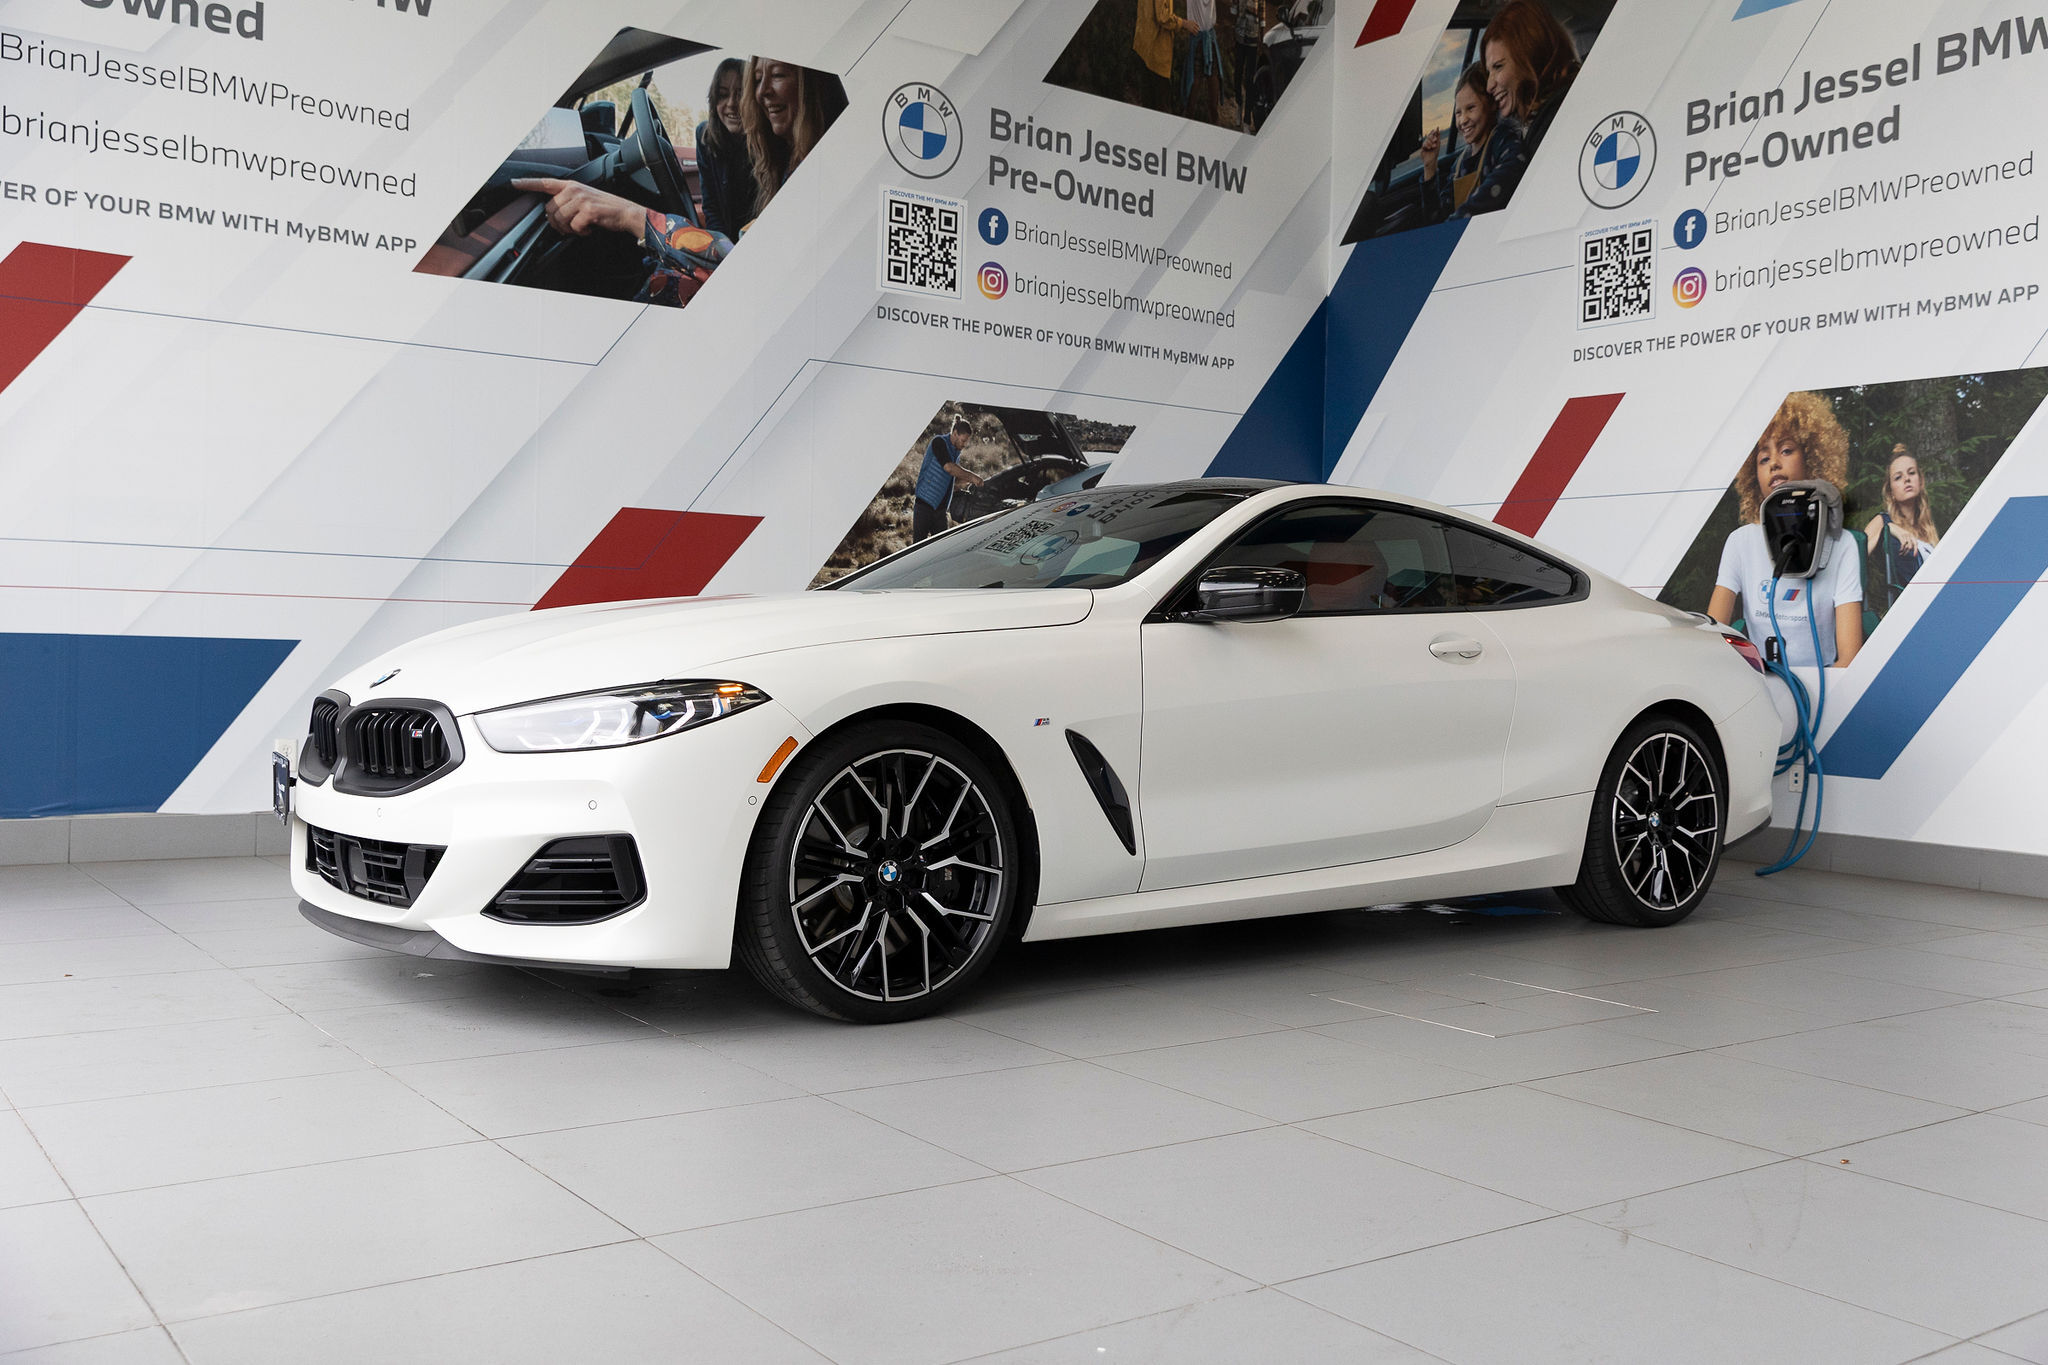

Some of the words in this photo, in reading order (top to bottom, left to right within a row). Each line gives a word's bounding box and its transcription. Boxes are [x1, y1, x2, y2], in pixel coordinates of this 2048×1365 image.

[80, 0, 264, 41] wned
[1, 32, 409, 131] BrianJesselBMWPreowned
[894, 87, 953, 118] BMW
[1686, 90, 1784, 137] Brian
[1794, 42, 1921, 115] Jessel
[1936, 15, 2048, 76] BMW
[2, 105, 416, 197] brianjesselbmwpreowned
[990, 107, 1072, 156] Brian
[1079, 129, 1167, 177] Jessel
[1176, 150, 1248, 195] BMW
[1589, 116, 1647, 148] BMW
[1685, 103, 1901, 187] Pre-Owned
[0, 181, 37, 202] ER
[44, 187, 78, 207] OF
[84, 191, 151, 217] YOUR
[158, 202, 215, 225] BMW
[222, 211, 279, 235] WITH
[286, 221, 370, 247] MyBMW
[375, 234, 417, 254] APP
[889, 189, 915, 199] DISCOVER
[934, 198, 947, 206] BMW
[988, 155, 1154, 218] Pre-Owned
[1715, 150, 2033, 234] BrianJesselBMWPreowned
[1014, 220, 1232, 280] BrianJesselBMWPreowned
[1584, 227, 1609, 237] DISCOVER
[1628, 221, 1640, 229] BMW
[1641, 218, 1652, 226] APP
[1715, 215, 2039, 292] brianjesselbmwpreowned
[1014, 272, 1235, 328] brianjesselbmwpreowned
[1573, 339, 1643, 362] DISCOVER
[1646, 335, 1676, 352] THE
[1680, 327, 1736, 348] POWER
[1740, 323, 1762, 339] OF
[1765, 316, 1811, 336] YOUR
[1816, 309, 1860, 329] BMW
[1864, 301, 1910, 322] WITH
[1916, 290, 1992, 317] MyBMW
[1997, 284, 2040, 304] APP
[877, 305, 949, 329] DISCOVER
[952, 317, 980, 334] THE
[984, 321, 1033, 341] POWER
[1036, 329, 1054, 343] OF
[1056, 332, 1091, 350] YOUR
[1094, 338, 1126, 354] BMW
[1128, 343, 1160, 360] WITH
[1163, 348, 1209, 367] MyBMW
[1211, 356, 1235, 370] APP
